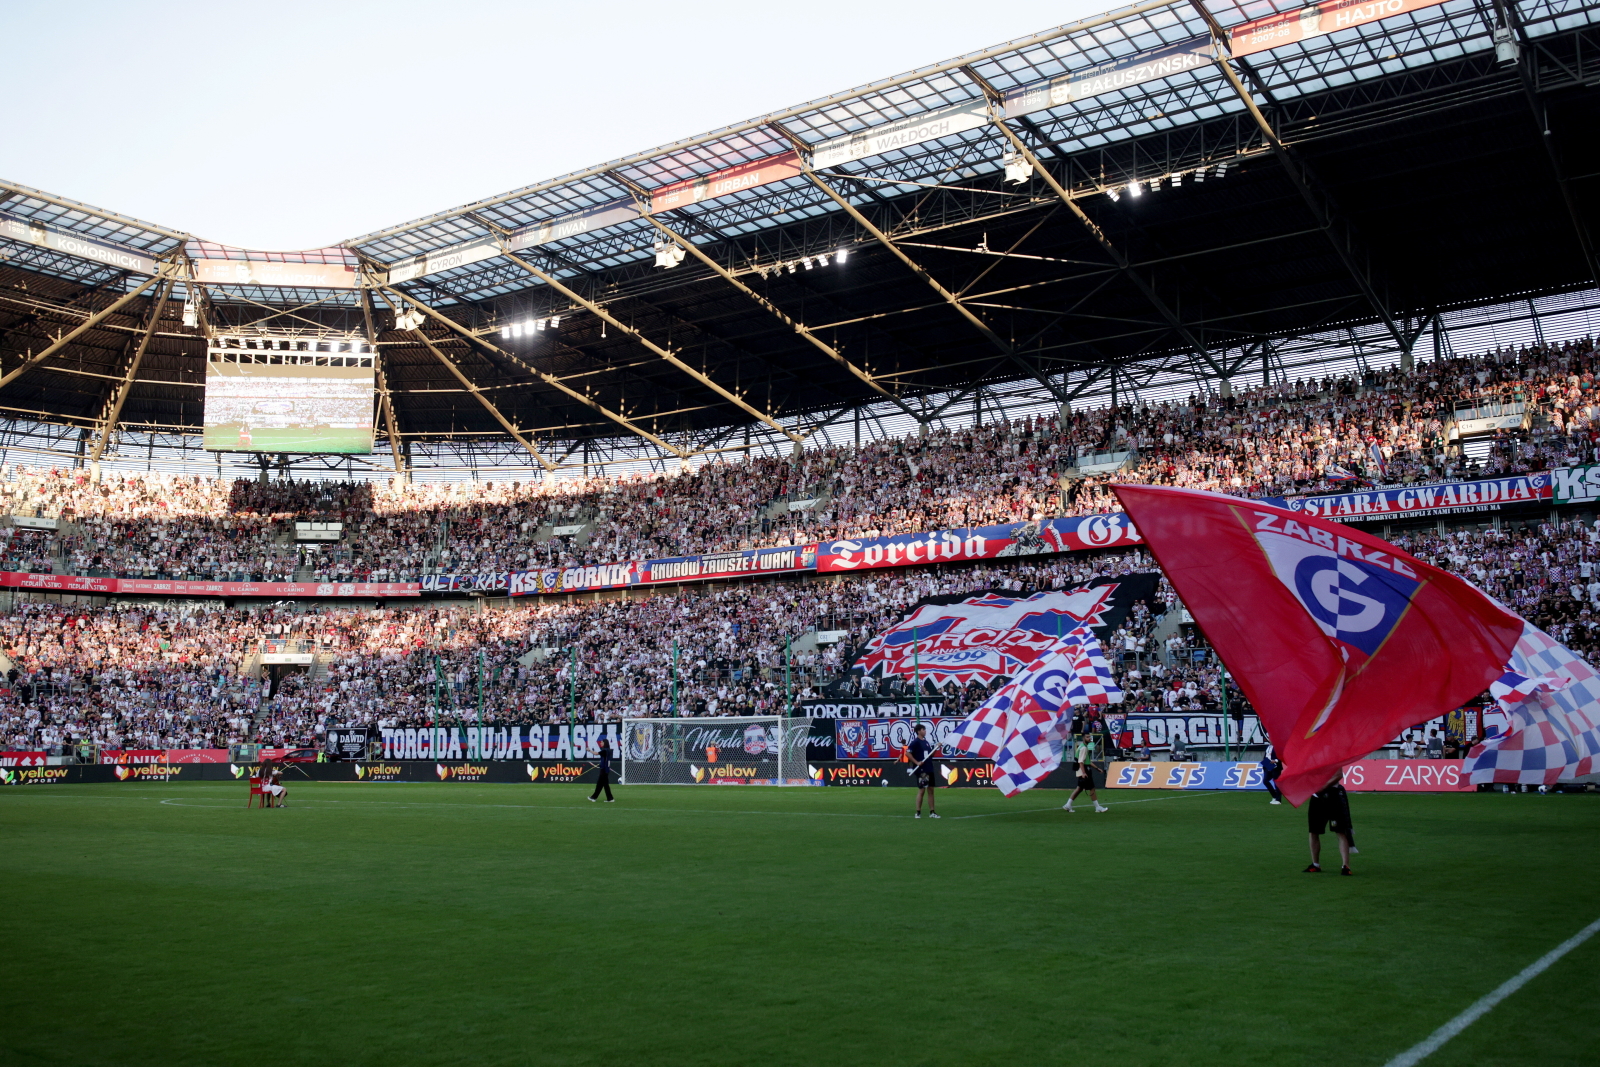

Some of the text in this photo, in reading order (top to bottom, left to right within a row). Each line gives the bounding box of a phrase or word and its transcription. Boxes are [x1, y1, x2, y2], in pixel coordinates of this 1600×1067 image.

[1336, 0, 1403, 27] HAJTO
[1251, 28, 1291, 45] 2007-08
[1080, 51, 1201, 96] BAŁUSZYŃSKI
[1022, 97, 1042, 107] 1994
[876, 120, 950, 150] WAŁDOCH
[715, 172, 759, 194] URBAN
[558, 219, 588, 237] IWAN
[57, 238, 142, 270] KOMORNICKI
[262, 273, 327, 285] WANDZIK
[1304, 477, 1532, 517] STARA GWARDIA
[1366, 513, 1398, 522] DOBRYCH
[1399, 511, 1426, 519] KUMPLI
[1432, 507, 1450, 516] NAMI
[1451, 506, 1475, 514] TUTAJ
[1476, 504, 1489, 513] NIE
[1490, 503, 1501, 511] MA
[830, 530, 988, 569] Torcida
[1253, 511, 1418, 579] ZABRZE
[650, 558, 701, 581] KNURÓW
[701, 556, 750, 575] ZAWSZE
[760, 550, 796, 570] WAMI
[205, 584, 224, 592] ZABRZE
[316, 583, 335, 596] STS
[337, 583, 356, 596] STS
[510, 573, 538, 594] KS
[802, 702, 944, 719] TORCIDA PDW
[340, 734, 365, 743] DAWID
[1126, 717, 1265, 748] TORCIDA
[382, 727, 462, 760] TORCIDA
[466, 726, 523, 760] RUDA
[19, 766, 69, 782] yellow
[132, 763, 182, 778] yellow
[367, 762, 402, 778] yellow
[450, 762, 488, 778] yellow
[541, 762, 582, 778] yellow
[708, 763, 758, 780] yellow
[828, 763, 883, 783] yellow
[1117, 762, 1156, 787] STS
[1166, 762, 1207, 788] STS
[1223, 762, 1263, 788] STS
[1384, 765, 1459, 786] ZARYS
